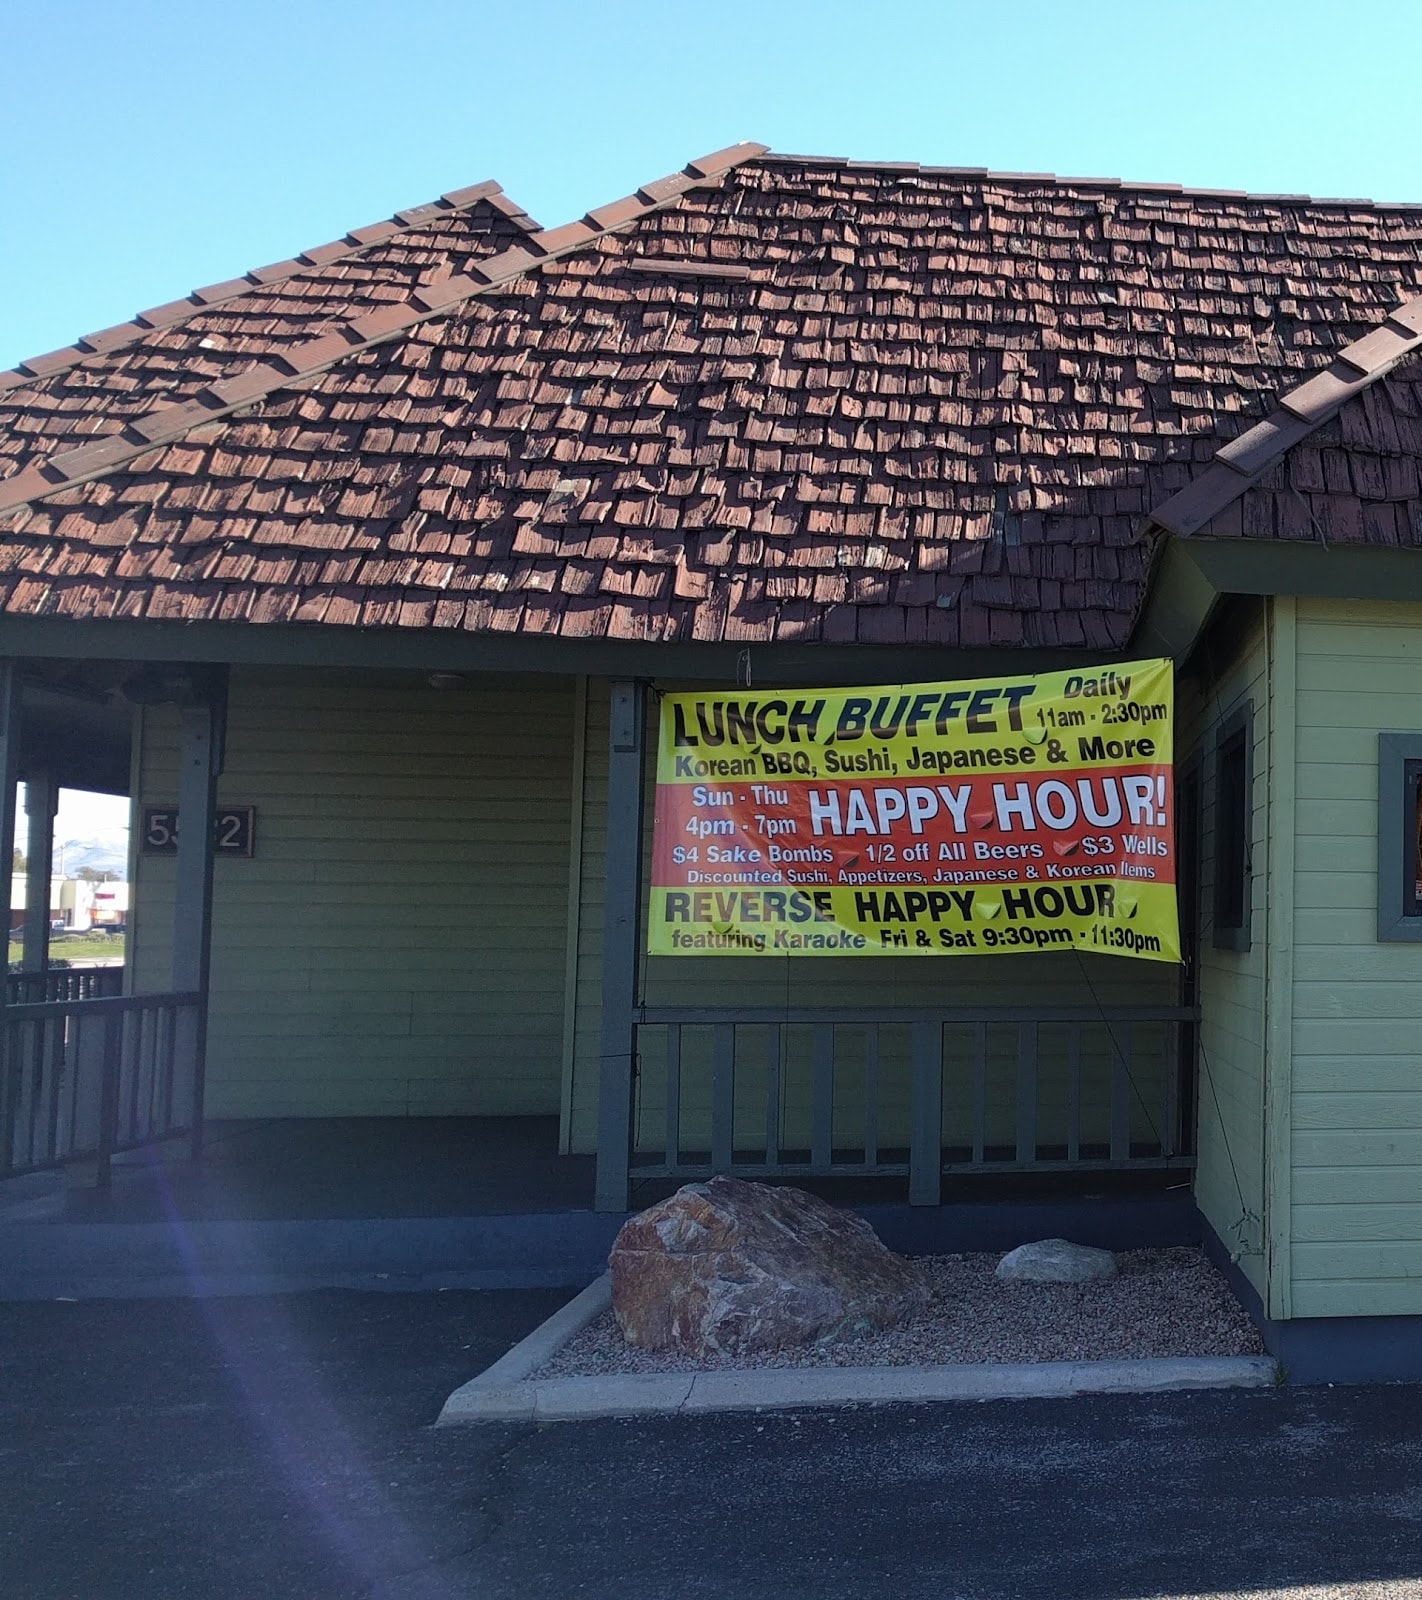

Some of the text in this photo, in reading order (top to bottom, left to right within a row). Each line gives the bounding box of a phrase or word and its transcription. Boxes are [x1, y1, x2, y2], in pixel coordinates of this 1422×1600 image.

[1064, 671, 1132, 700] Daily
[673, 685, 1037, 747] LUNCH BUFFET
[1037, 707, 1086, 728] 11am
[1102, 702, 1167, 726] 2:30pm
[675, 736, 1155, 778] Korean BBQ, Sushi, Japanese & More
[692, 786, 734, 807] Sun
[751, 785, 788, 805] Thu
[808, 774, 1167, 837] HAPPY HOUR!
[685, 815, 735, 839] 4pm
[754, 814, 797, 838] 7pm
[672, 844, 834, 864] $4 Sake Bombs
[866, 841, 1044, 863] 1/2 off All Beers
[1081, 834, 1168, 857] $3 Wells
[687, 860, 1155, 886] Discounted Sushi, Appetizers, Japanese & Korean Items
[665, 884, 1115, 922] REVERSE HAPPY HOUR
[672, 930, 766, 952] featuring
[774, 929, 866, 949] Karaoke
[881, 929, 907, 948] Fri
[916, 929, 931, 947] &
[939, 928, 977, 947] Sat
[982, 927, 1073, 947] 9:30pm
[1092, 923, 1160, 952] 11:30pm
